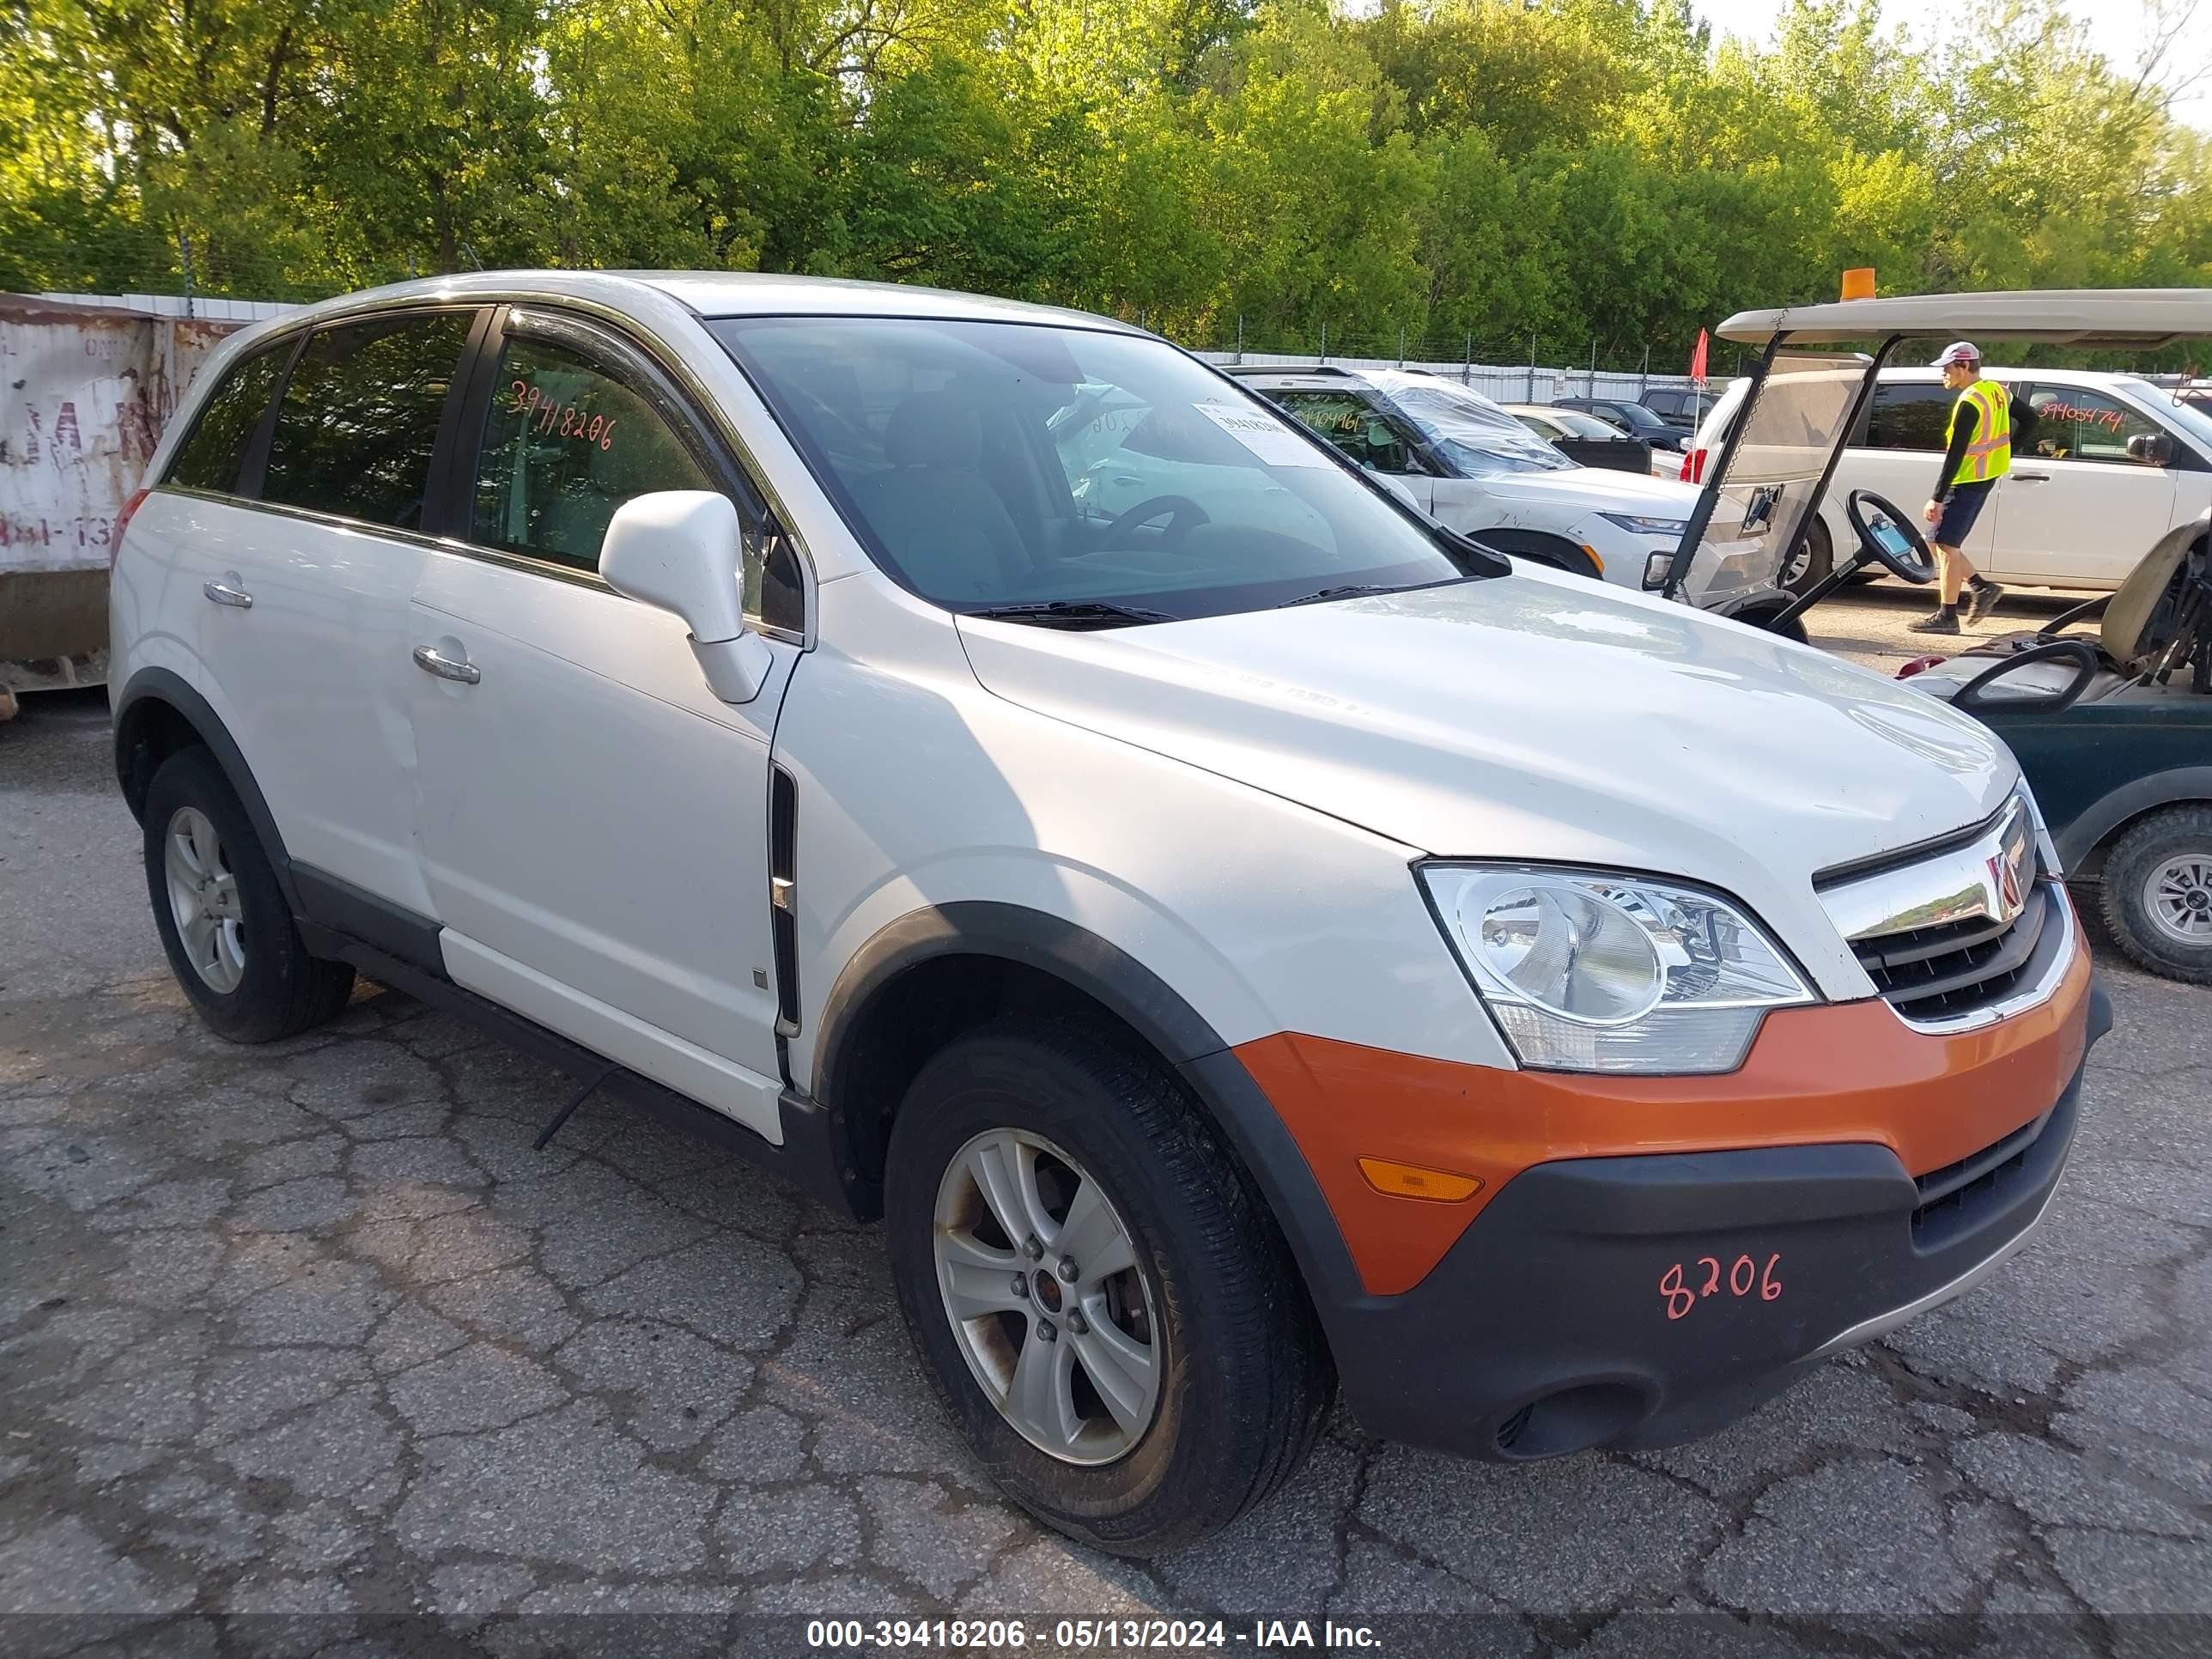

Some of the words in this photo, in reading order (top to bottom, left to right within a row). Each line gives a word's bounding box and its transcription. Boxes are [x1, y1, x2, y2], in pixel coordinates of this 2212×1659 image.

[506, 380, 617, 451] 39418206
[2038, 403, 2124, 433] 39405474
[1659, 1253, 1784, 1321] 8206
